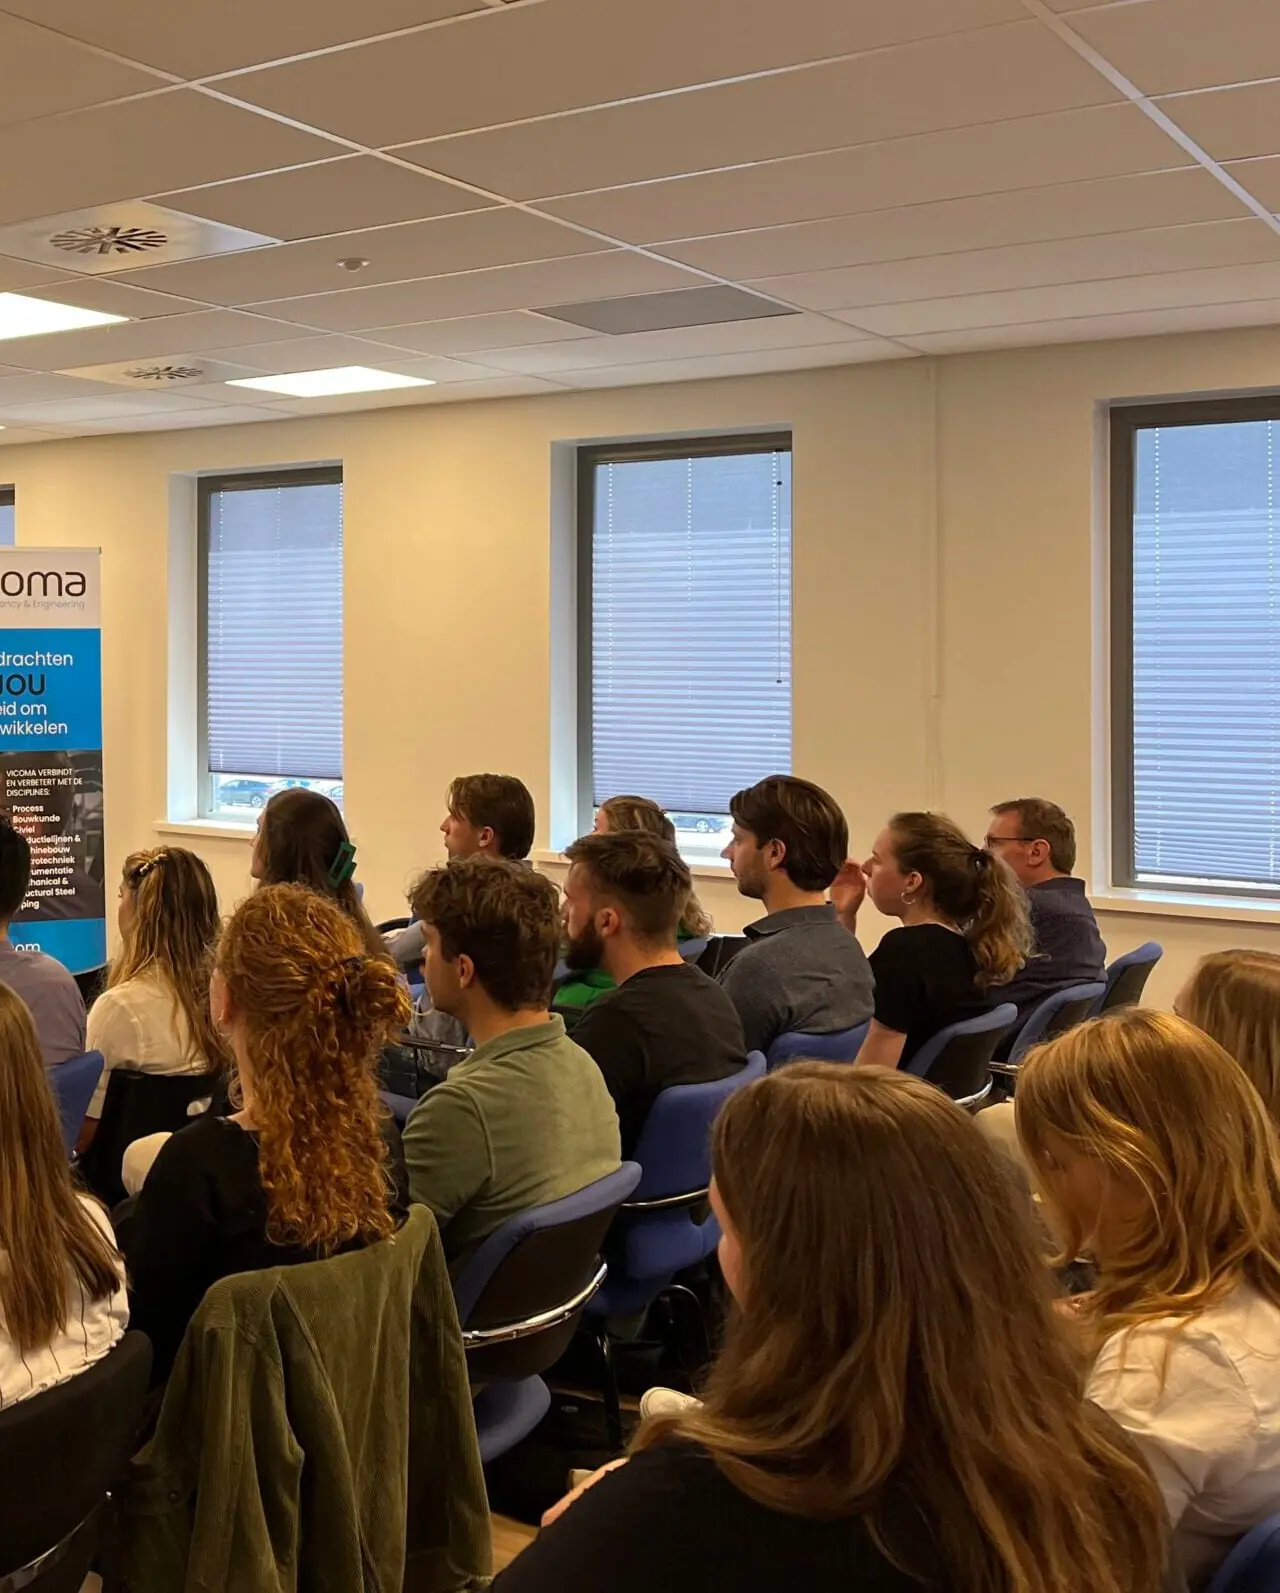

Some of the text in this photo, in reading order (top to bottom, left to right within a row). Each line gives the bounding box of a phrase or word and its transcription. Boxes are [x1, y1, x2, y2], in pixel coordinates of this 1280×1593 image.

[23, 599, 31, 608] &
[32, 599, 86, 611] Engineering
[20, 703, 47, 716] om
[6, 768, 72, 777] VICOMA VERBINDT
[6, 777, 83, 787] EN VERBETERT MET DE
[12, 805, 44, 813] Process
[12, 814, 60, 824] Bouwkunde
[26, 834, 81, 845] ductielijnen &
[30, 845, 70, 854] hinebouw
[30, 855, 76, 865] rotechniek
[31, 866, 74, 876] umentatie
[28, 877, 69, 886] hanical &
[25, 886, 76, 897] uctural Steel
[21, 899, 40, 911] ping
